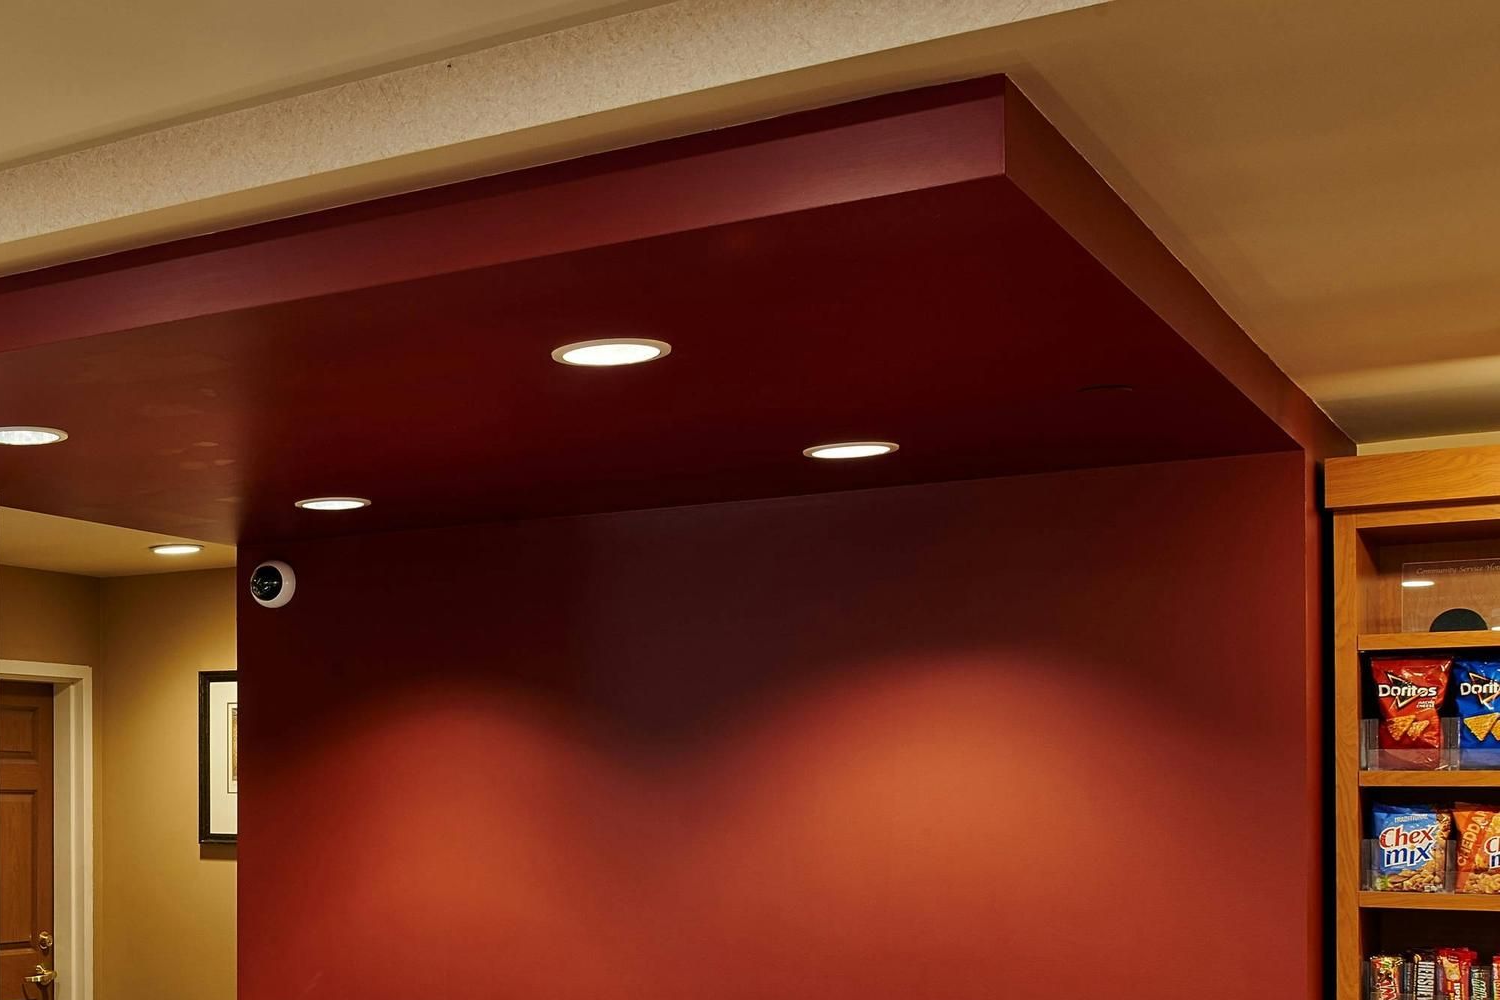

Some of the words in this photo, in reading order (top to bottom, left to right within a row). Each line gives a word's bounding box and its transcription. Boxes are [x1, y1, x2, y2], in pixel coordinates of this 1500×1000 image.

[1378, 684, 1437, 697] Doritos
[1460, 682, 1500, 696] Dorit
[1380, 826, 1437, 849] Chex
